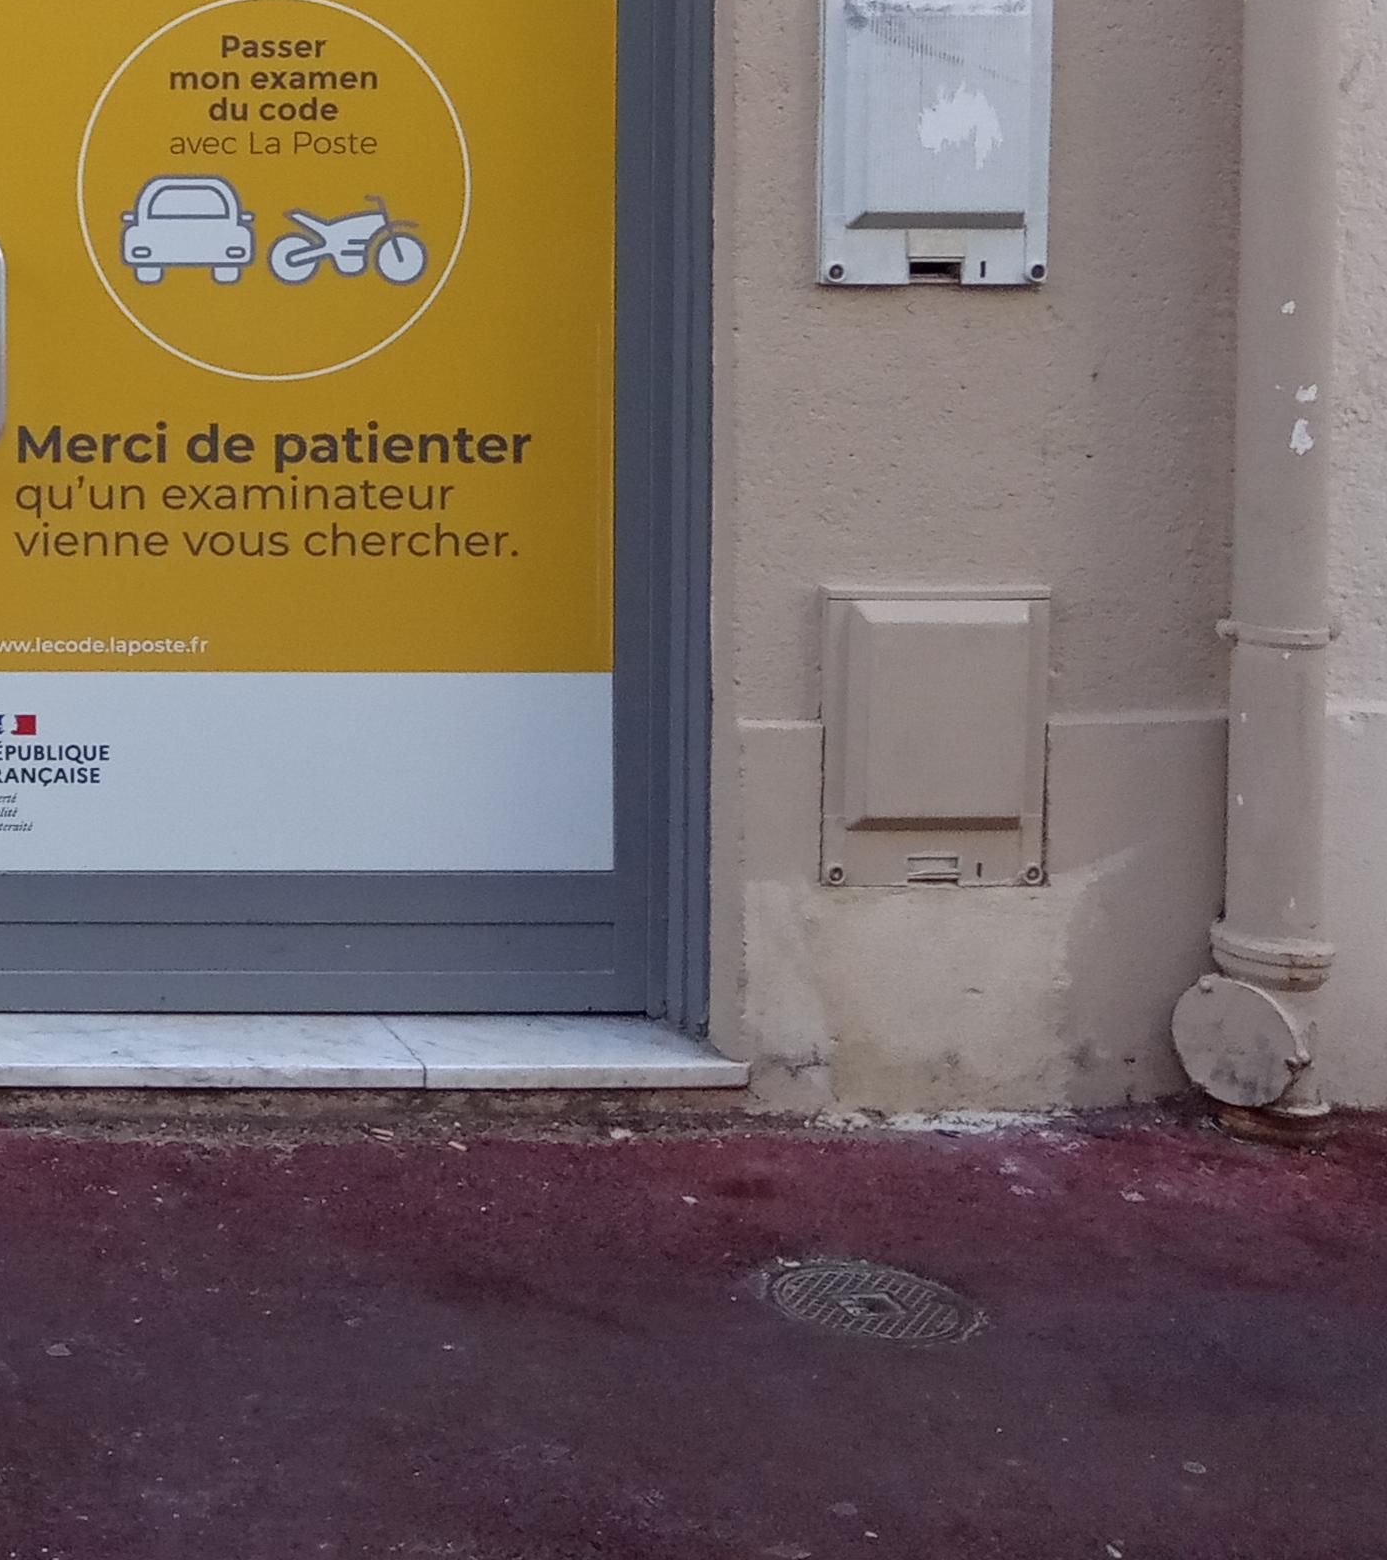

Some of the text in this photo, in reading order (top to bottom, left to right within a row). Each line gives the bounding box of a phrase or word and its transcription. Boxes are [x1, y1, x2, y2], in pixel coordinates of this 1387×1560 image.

[222, 35, 327, 58] Passer
[170, 71, 377, 90] mon examen
[209, 97, 339, 121] du code
[170, 131, 377, 155] avec La Poste
[18, 421, 532, 473] Merci de patienter
[16, 475, 454, 518] qu’un examinateur
[14, 522, 518, 557] vienne vous chercher.
